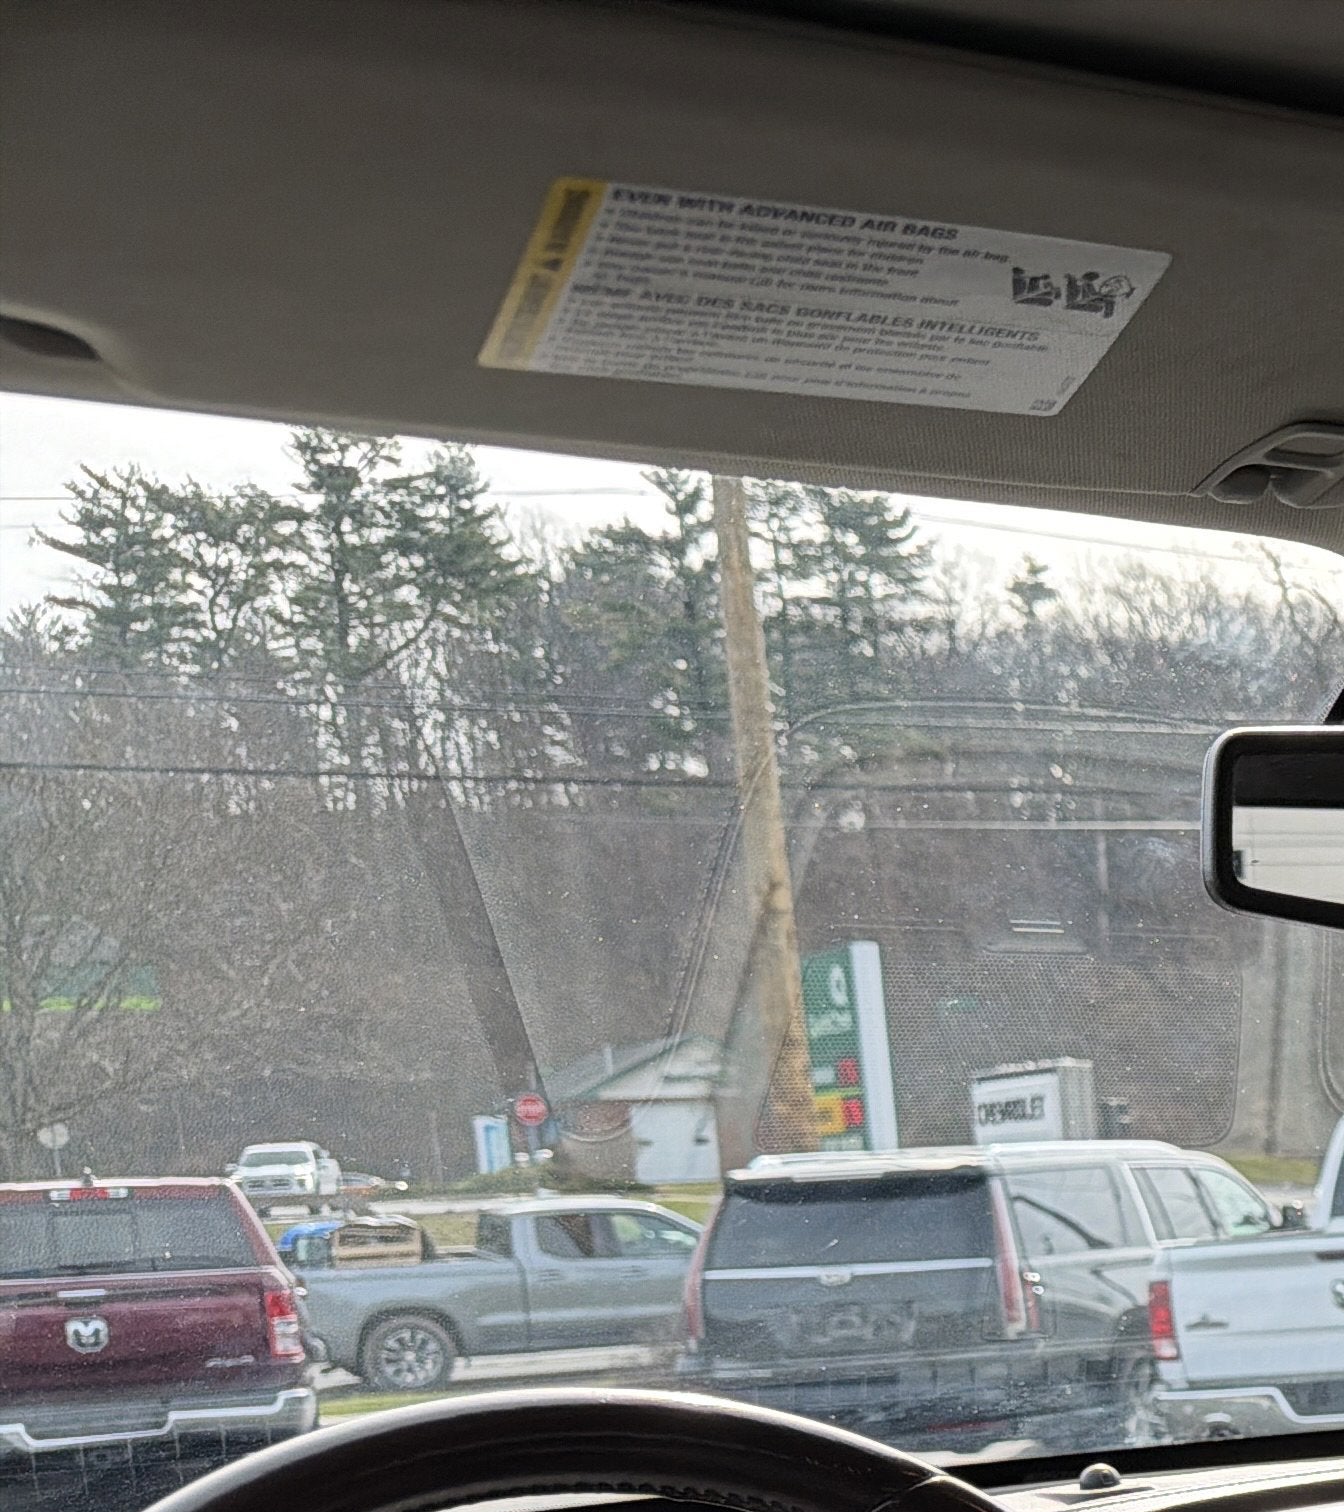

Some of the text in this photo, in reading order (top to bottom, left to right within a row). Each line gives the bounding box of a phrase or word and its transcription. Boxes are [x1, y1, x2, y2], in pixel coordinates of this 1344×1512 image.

[677, 196, 736, 213] WITH
[738, 204, 856, 228] ADVANCED
[859, 219, 898, 231] AIR
[902, 222, 960, 240] BAGS
[697, 296, 735, 308] DES
[739, 302, 790, 316] SACS
[795, 306, 914, 329] GONFLABLES
[917, 319, 1041, 343] INTELLIGENTS
